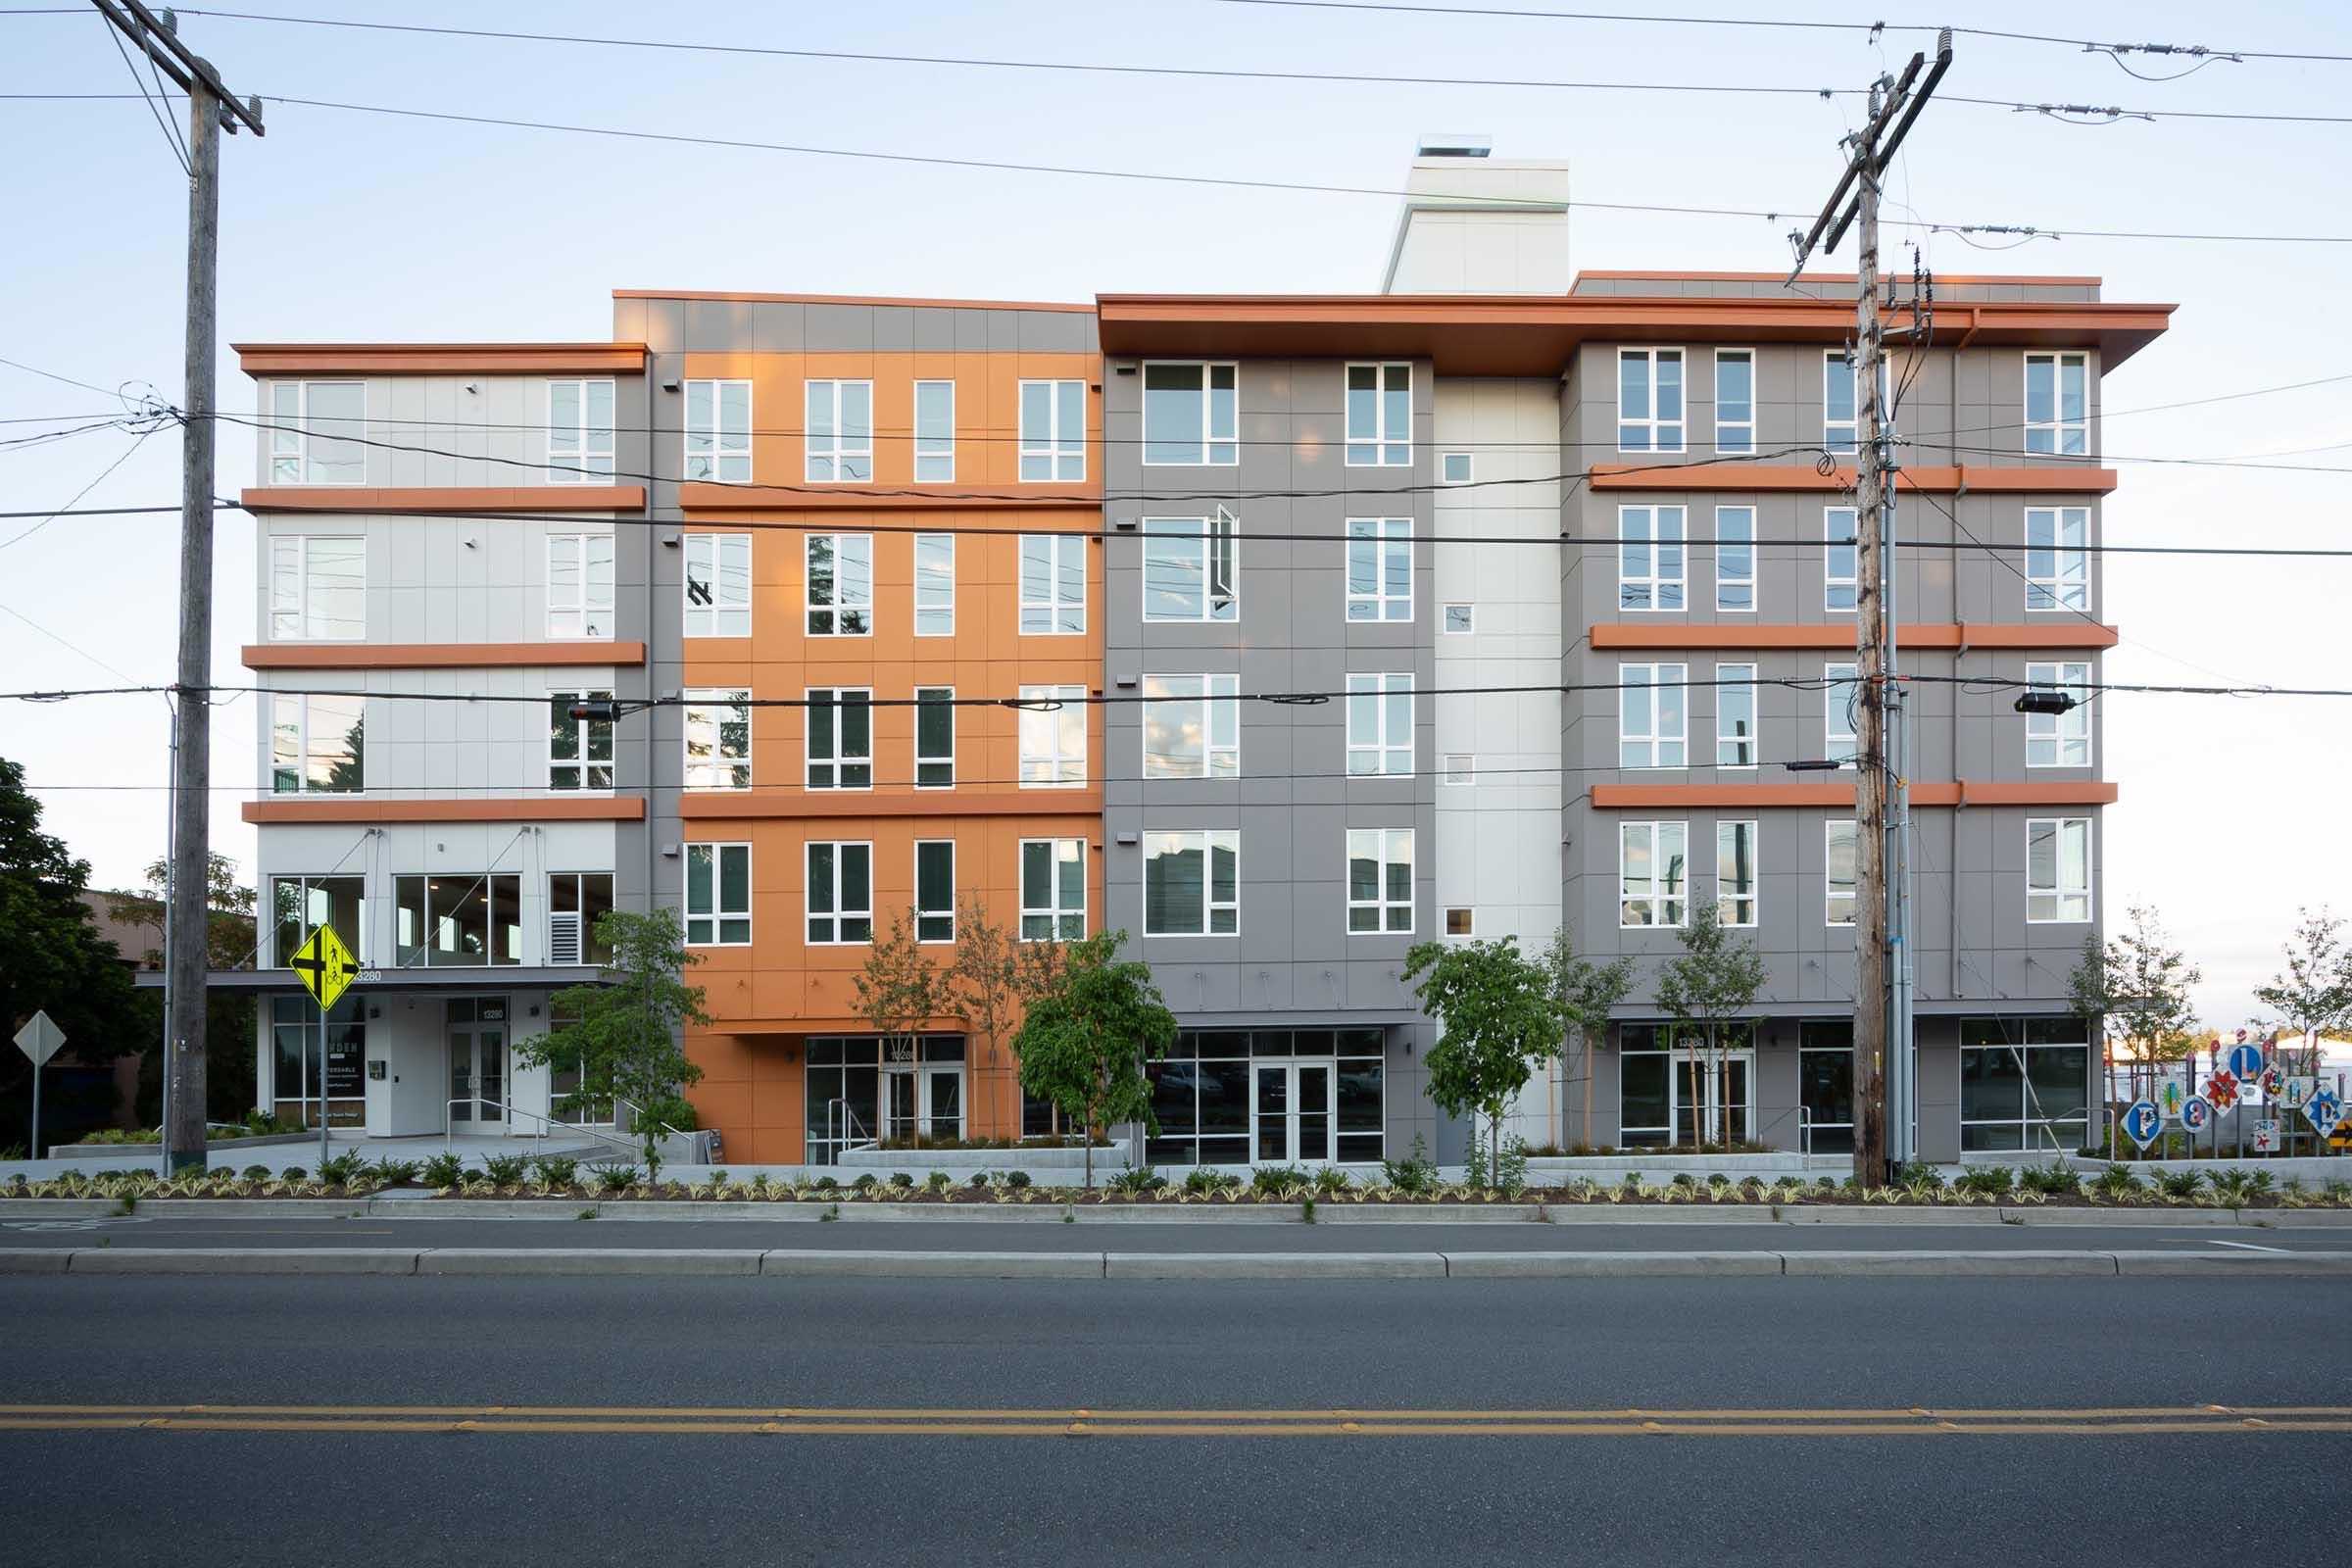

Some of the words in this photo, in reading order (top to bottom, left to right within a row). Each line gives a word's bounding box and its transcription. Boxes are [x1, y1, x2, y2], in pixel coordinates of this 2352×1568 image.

[355, 971, 381, 981] 3280
[1679, 1037, 1704, 1047] 1380
[891, 1051, 913, 1059] 128
